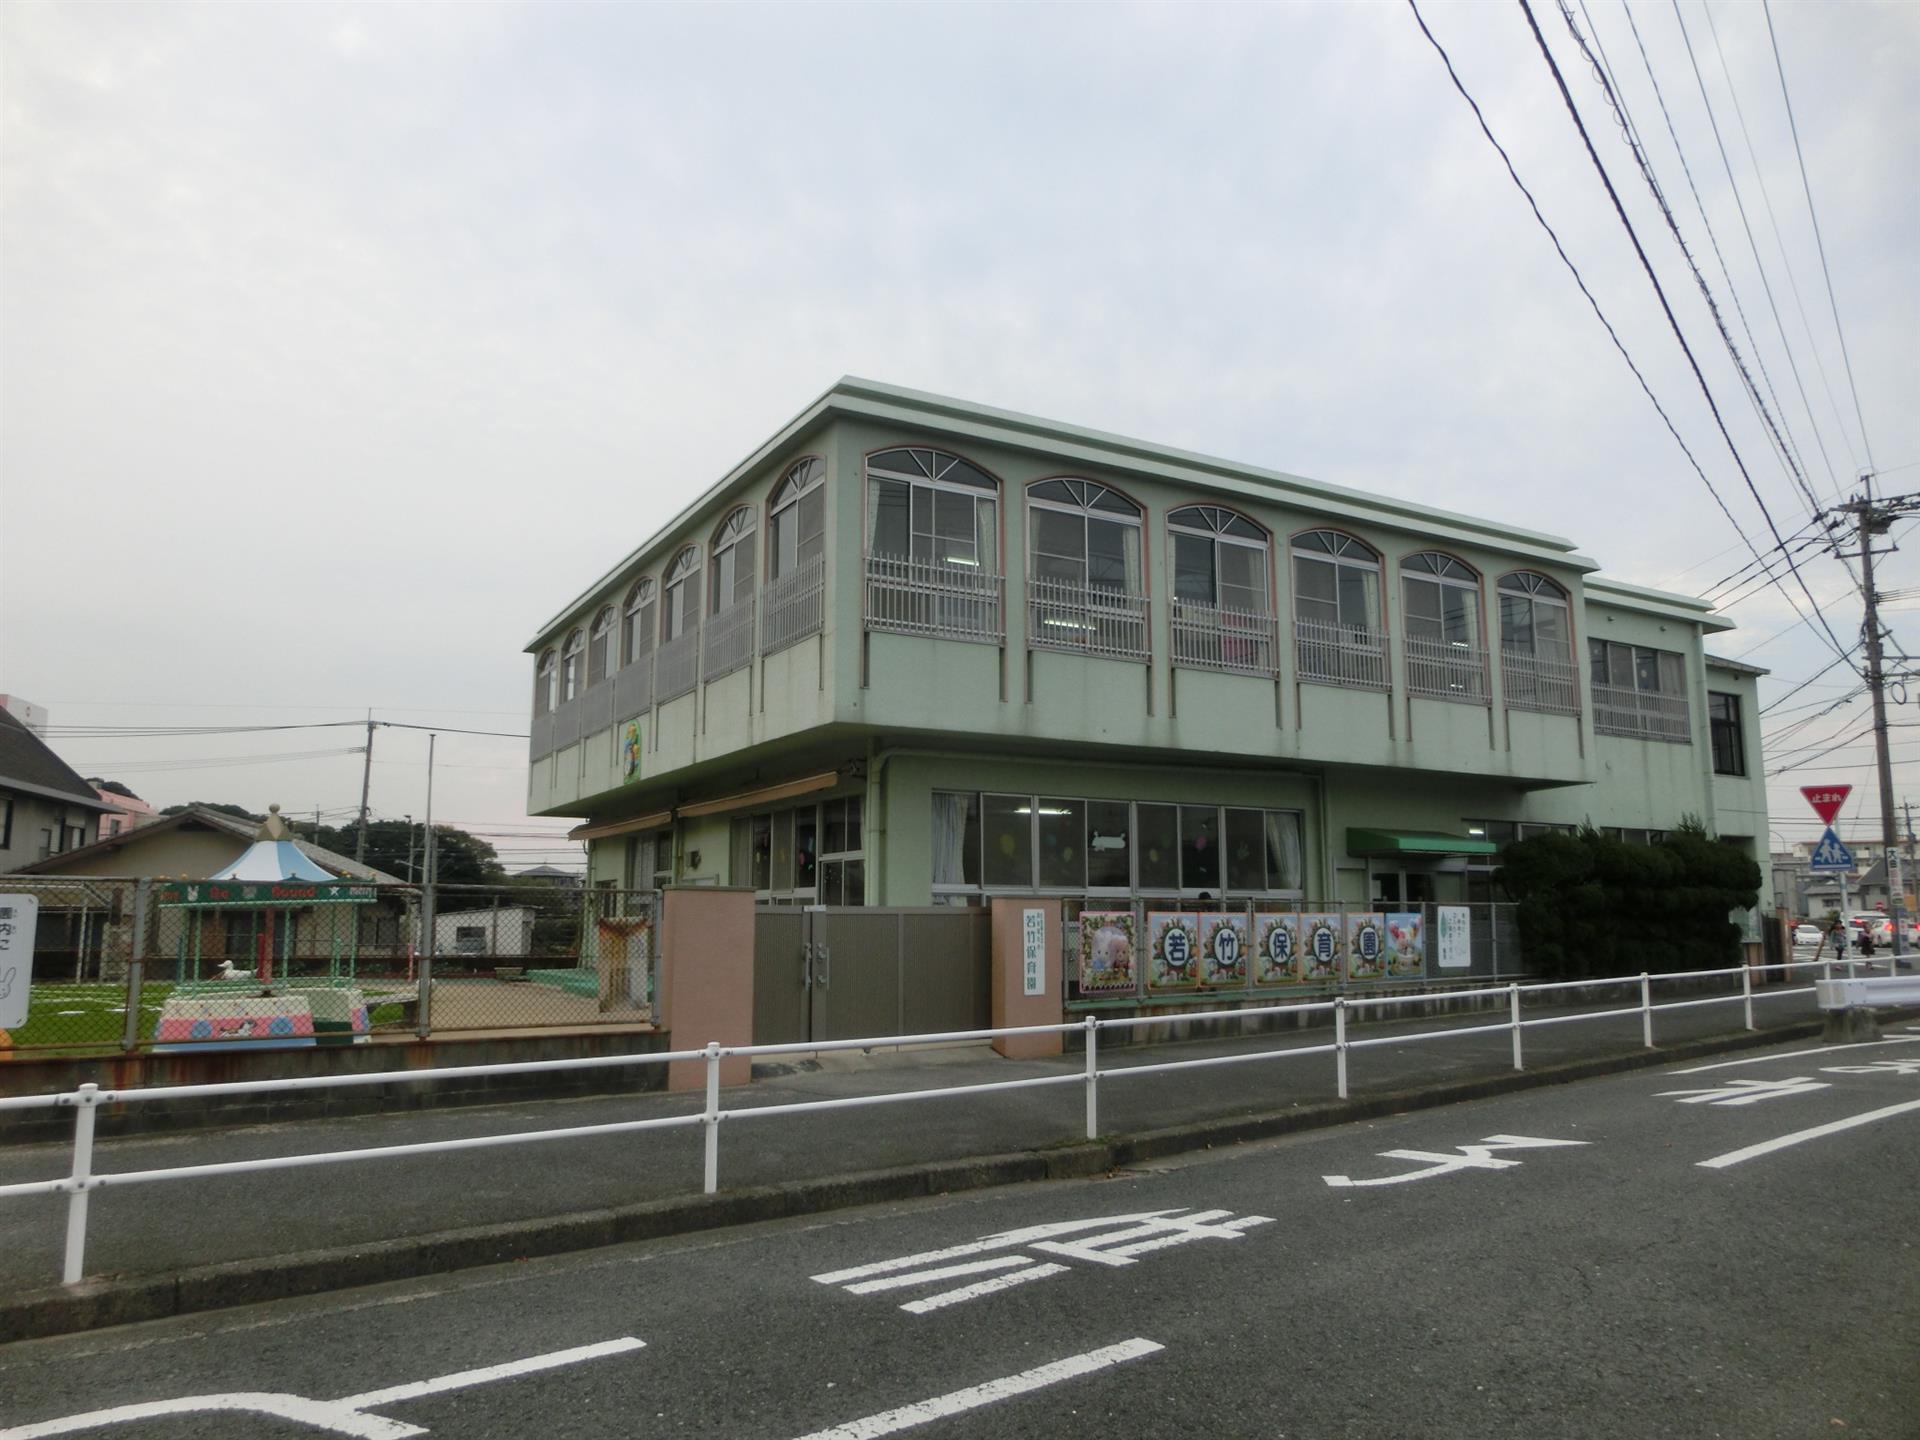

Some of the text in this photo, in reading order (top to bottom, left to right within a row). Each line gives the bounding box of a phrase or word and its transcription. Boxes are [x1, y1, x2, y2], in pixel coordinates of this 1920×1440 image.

[1812, 793, 1841, 803] 止まれ
[1026, 915, 1036, 990] 若竹保育園
[1169, 931, 1376, 961] 若竹保育園
